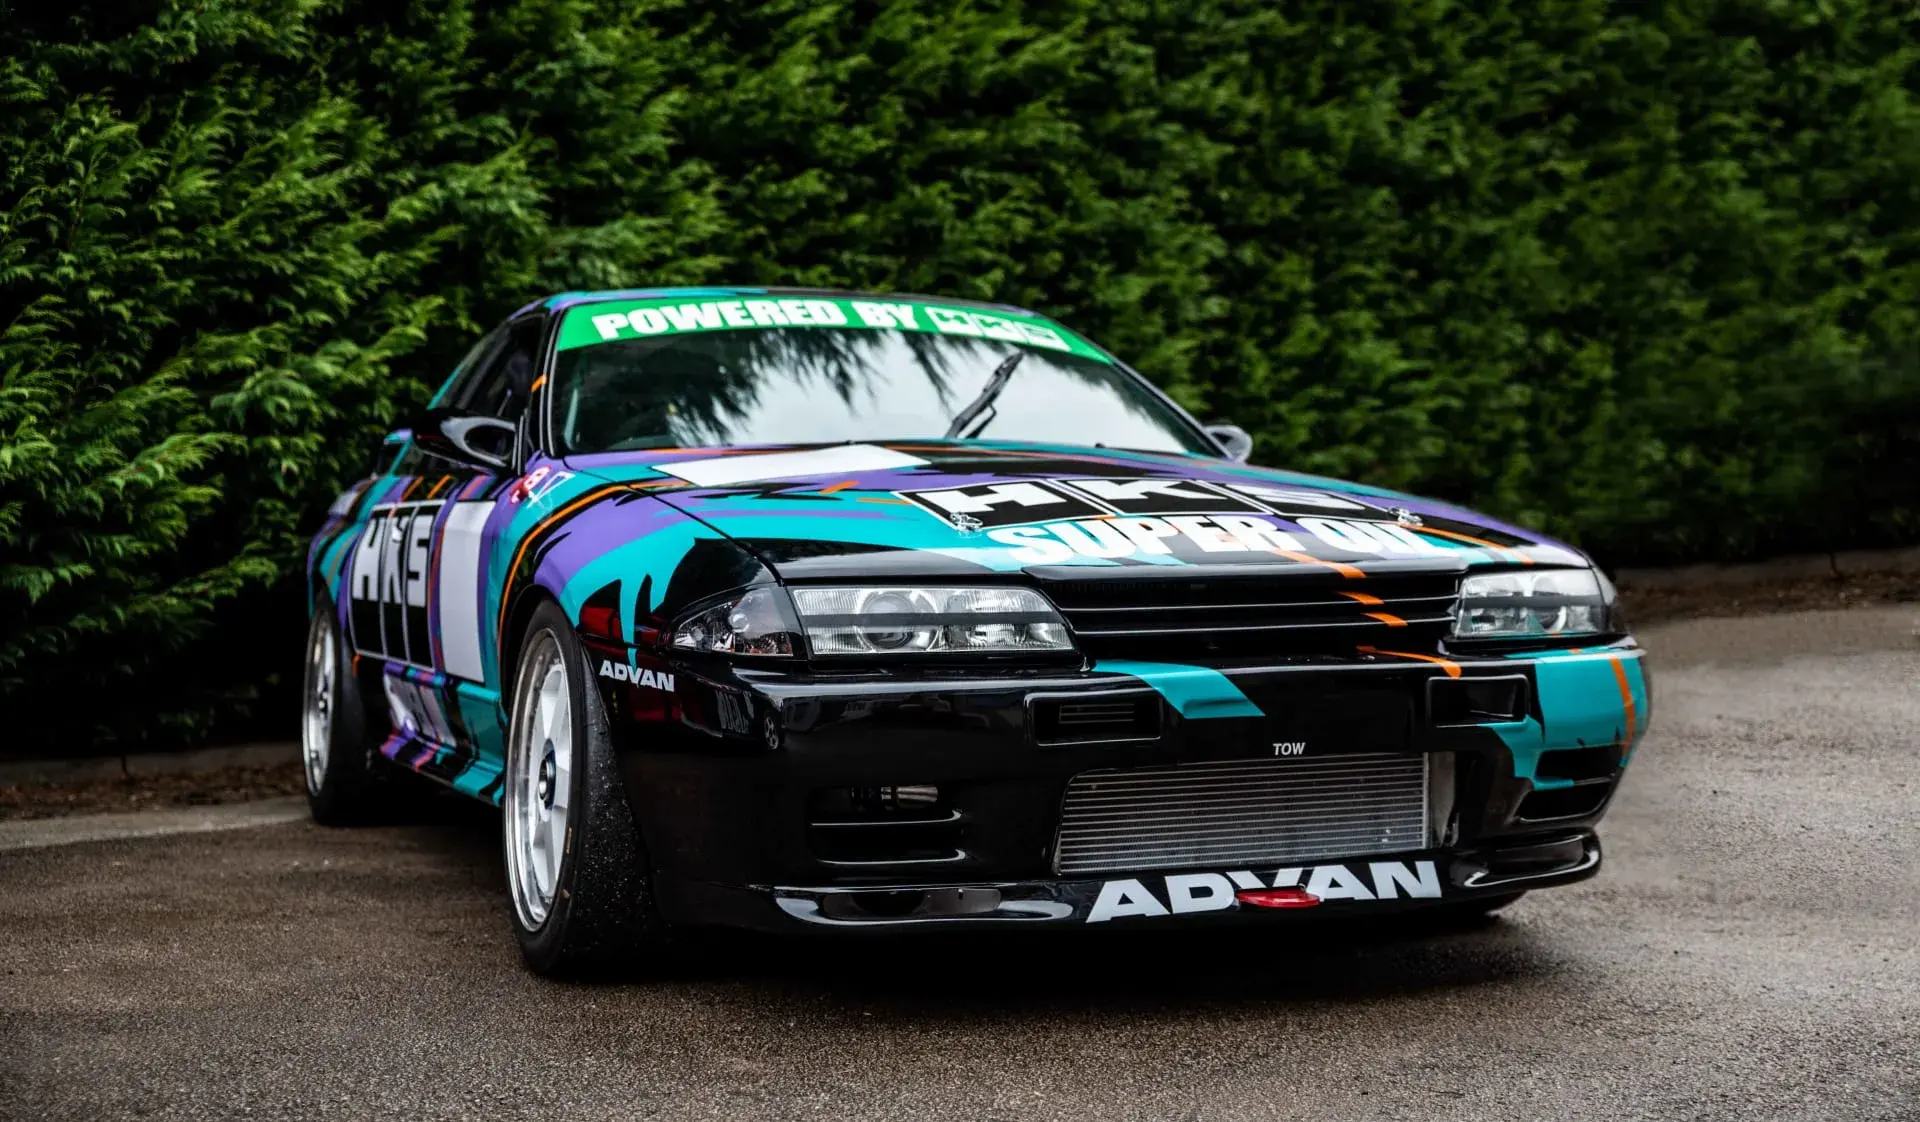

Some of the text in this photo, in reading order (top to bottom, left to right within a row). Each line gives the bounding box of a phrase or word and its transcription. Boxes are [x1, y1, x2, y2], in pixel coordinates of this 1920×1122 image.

[592, 299, 847, 341] POWERED
[851, 300, 919, 330] BY
[912, 480, 1368, 516] HKS
[986, 515, 1458, 563] SUPER OIL
[352, 515, 434, 608] HKS
[599, 659, 675, 692] ADVAN
[1272, 742, 1306, 756] TOW
